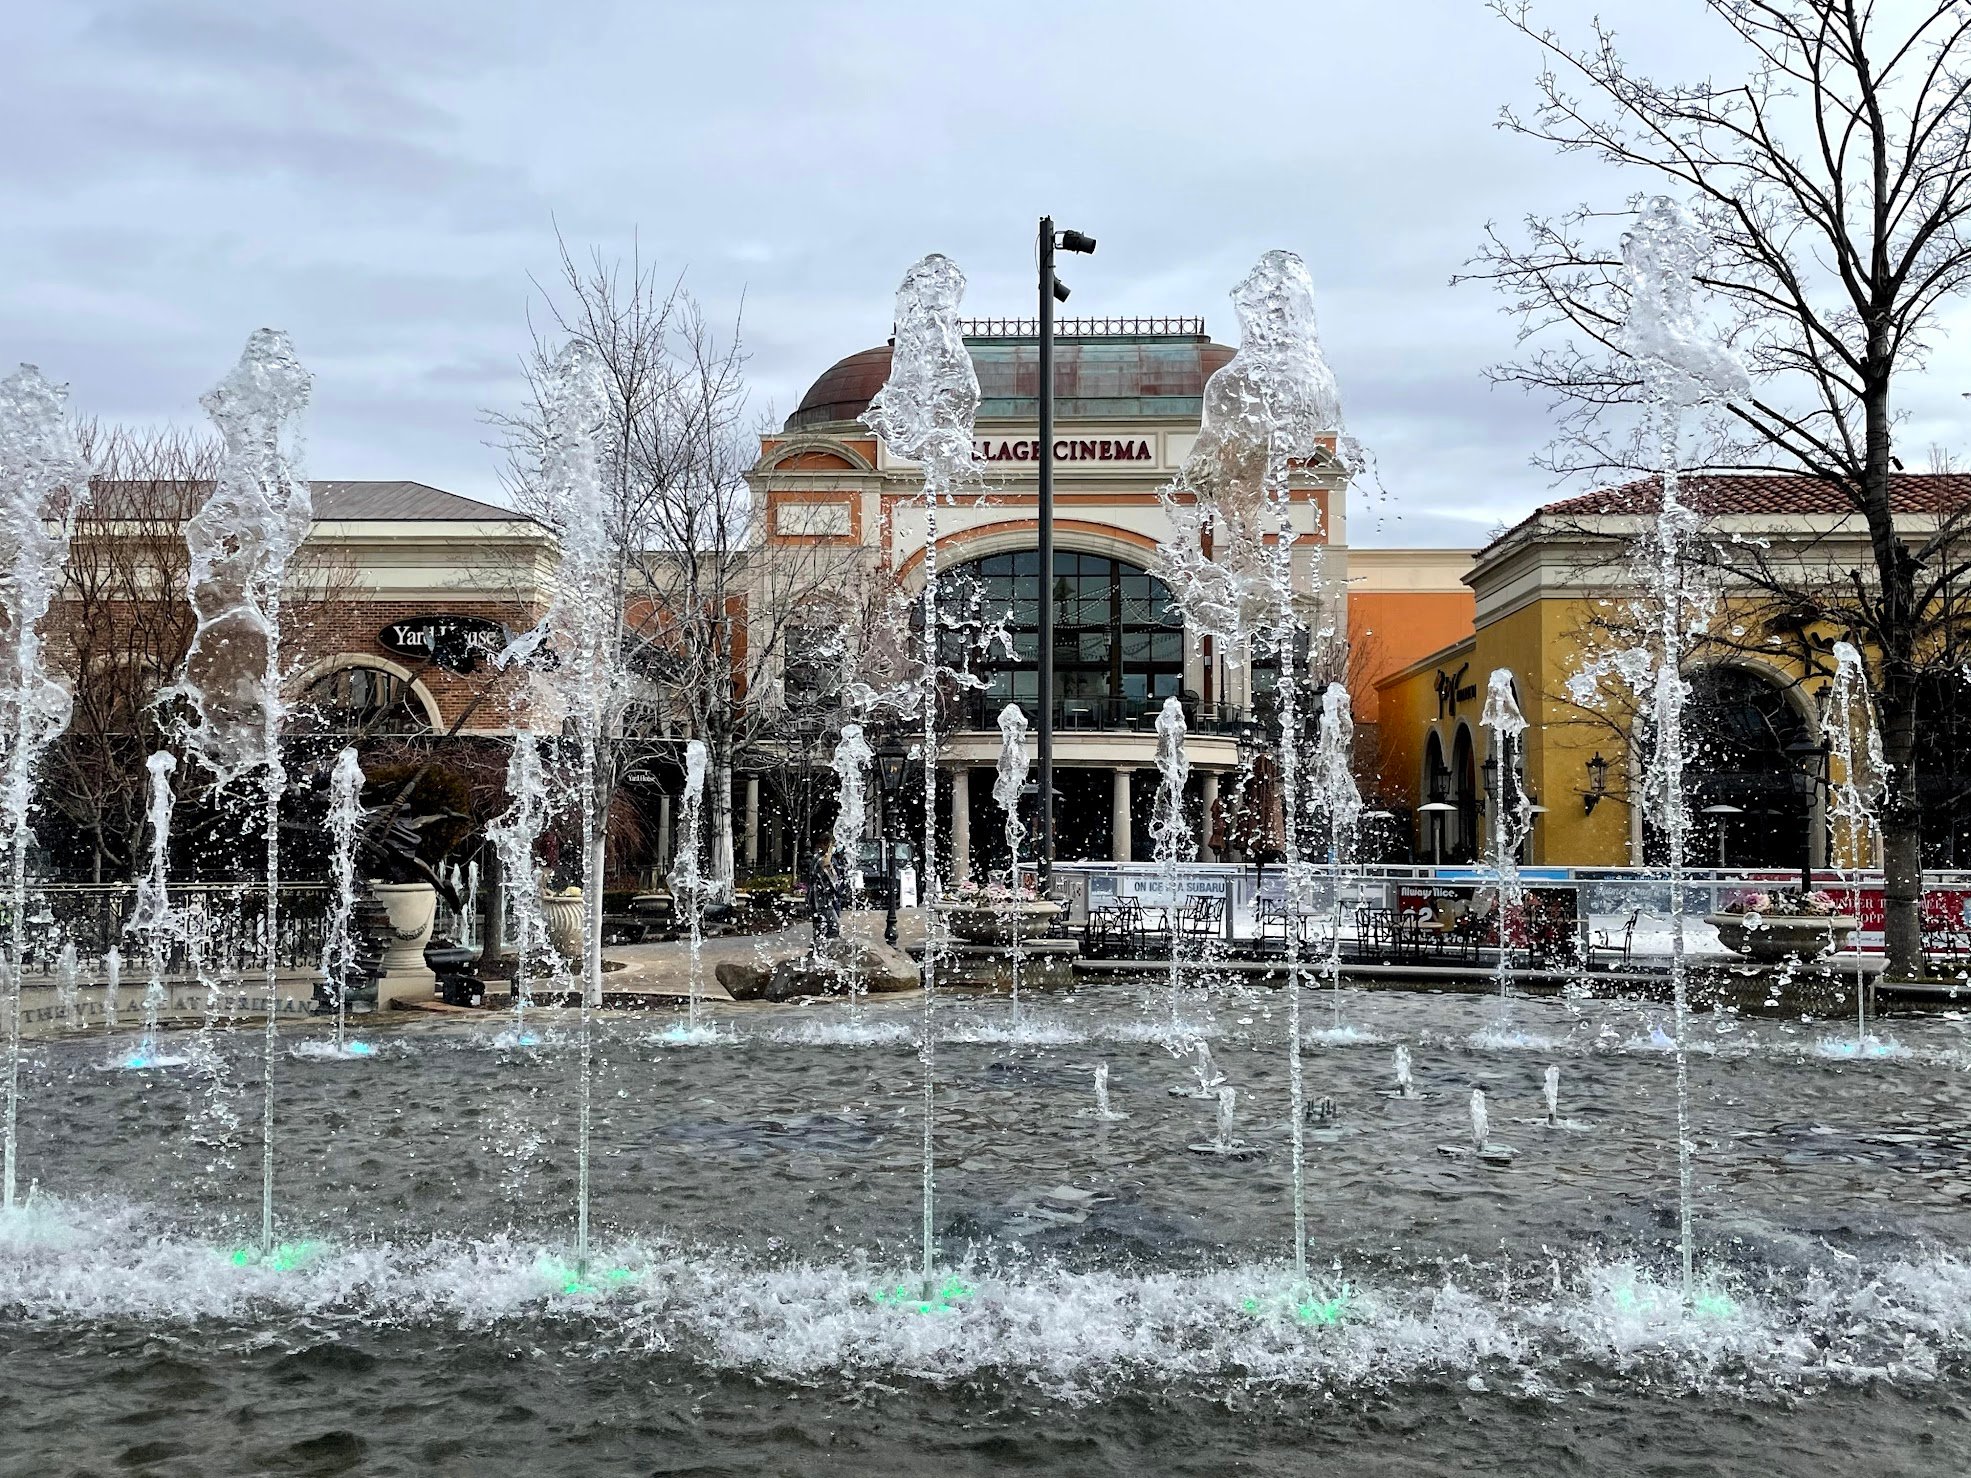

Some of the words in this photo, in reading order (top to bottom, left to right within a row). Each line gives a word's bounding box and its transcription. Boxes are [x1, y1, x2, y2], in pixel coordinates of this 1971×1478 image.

[971, 440, 1040, 461] LLAGE
[1053, 440, 1152, 461] CINEMA
[439, 625, 497, 646] use
[1134, 881, 1147, 892] ON
[1149, 881, 1163, 892] ICE
[1186, 882, 1225, 893] SUBARU
[1401, 886, 1432, 899] Always
[1433, 887, 1458, 898] Nice.
[21, 1004, 66, 1022] THE
[74, 1000, 167, 1016] VILAE
